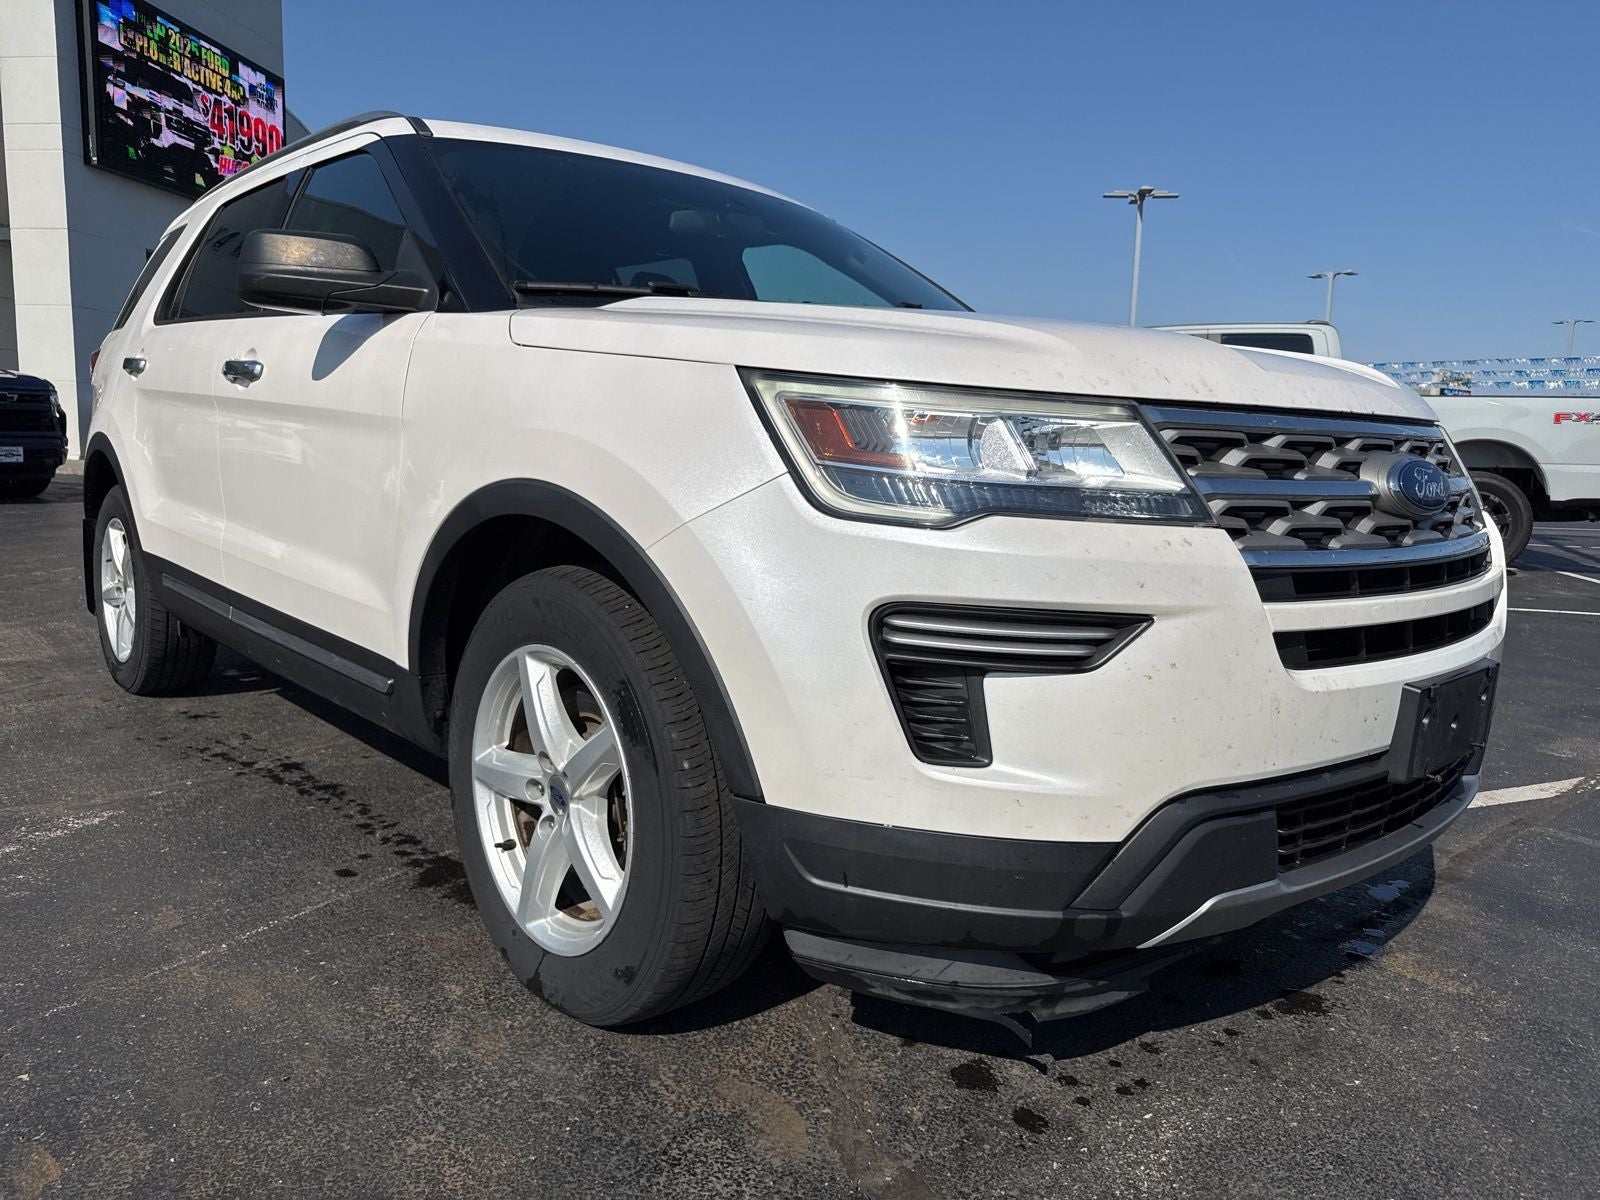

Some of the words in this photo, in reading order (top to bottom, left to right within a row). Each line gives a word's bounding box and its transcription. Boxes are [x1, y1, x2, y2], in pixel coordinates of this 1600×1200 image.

[183, 56, 224, 95] ACTIVE
[201, 45, 230, 78] FORD
[1413, 466, 1446, 499] Ford
